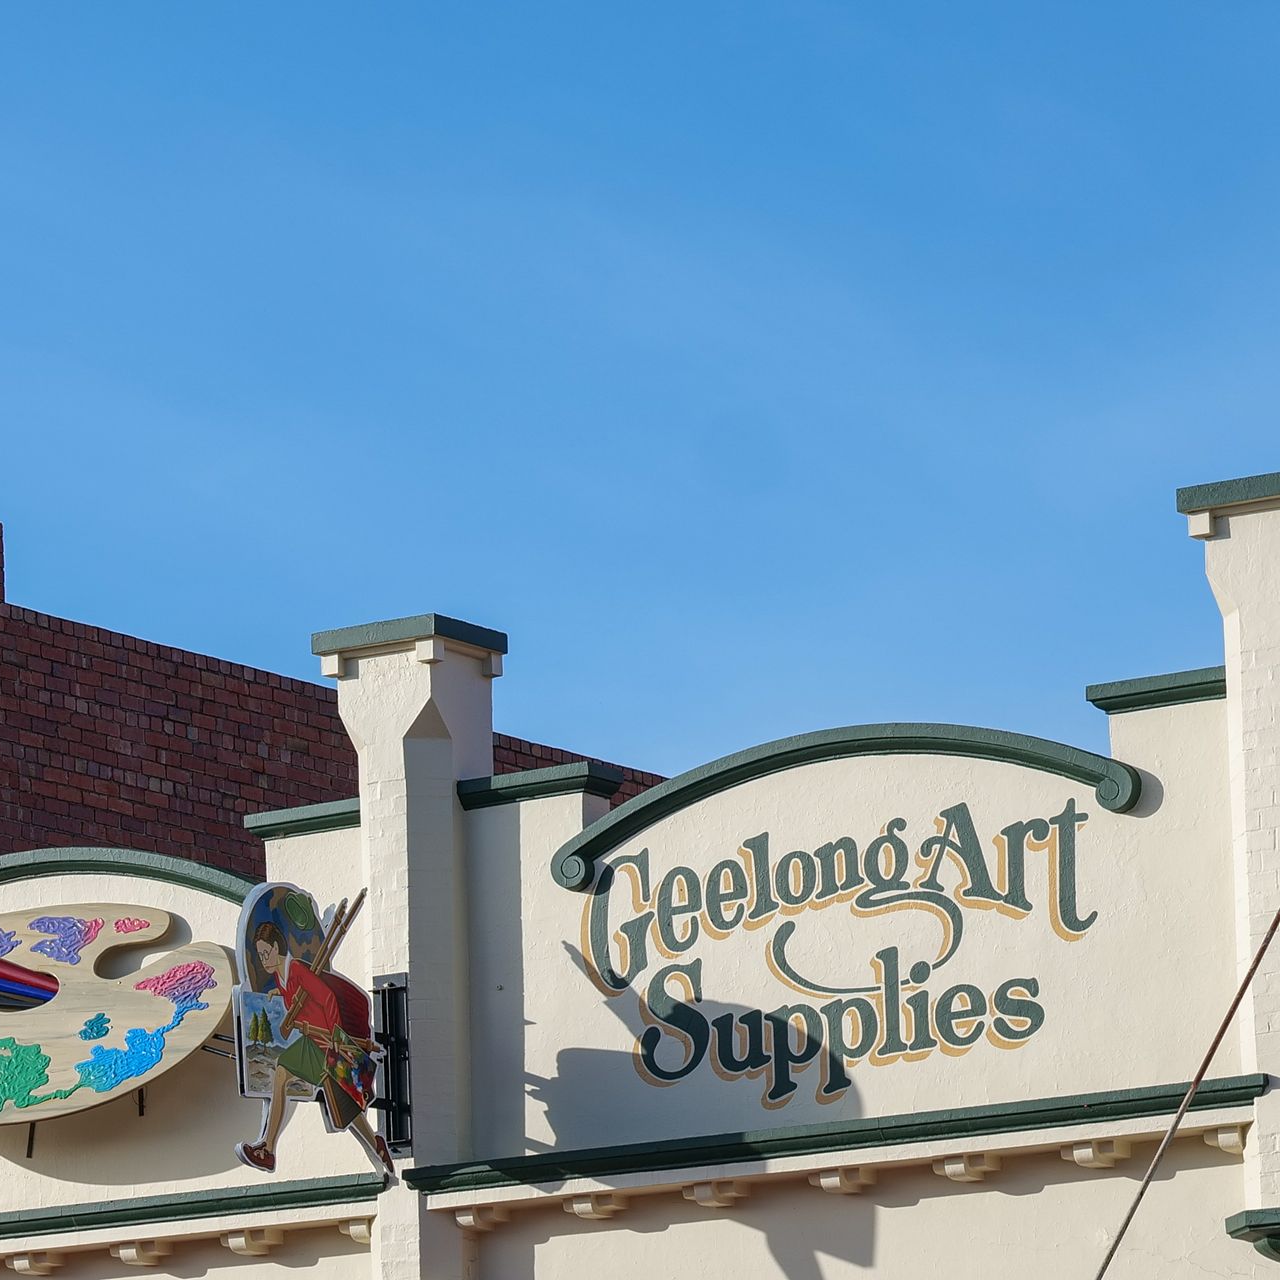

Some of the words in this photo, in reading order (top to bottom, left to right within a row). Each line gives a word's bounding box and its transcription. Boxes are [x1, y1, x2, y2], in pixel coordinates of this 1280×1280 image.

[580, 817, 962, 997] Geelong
[915, 798, 1098, 942] Art
[633, 946, 1045, 1111] Supplies
